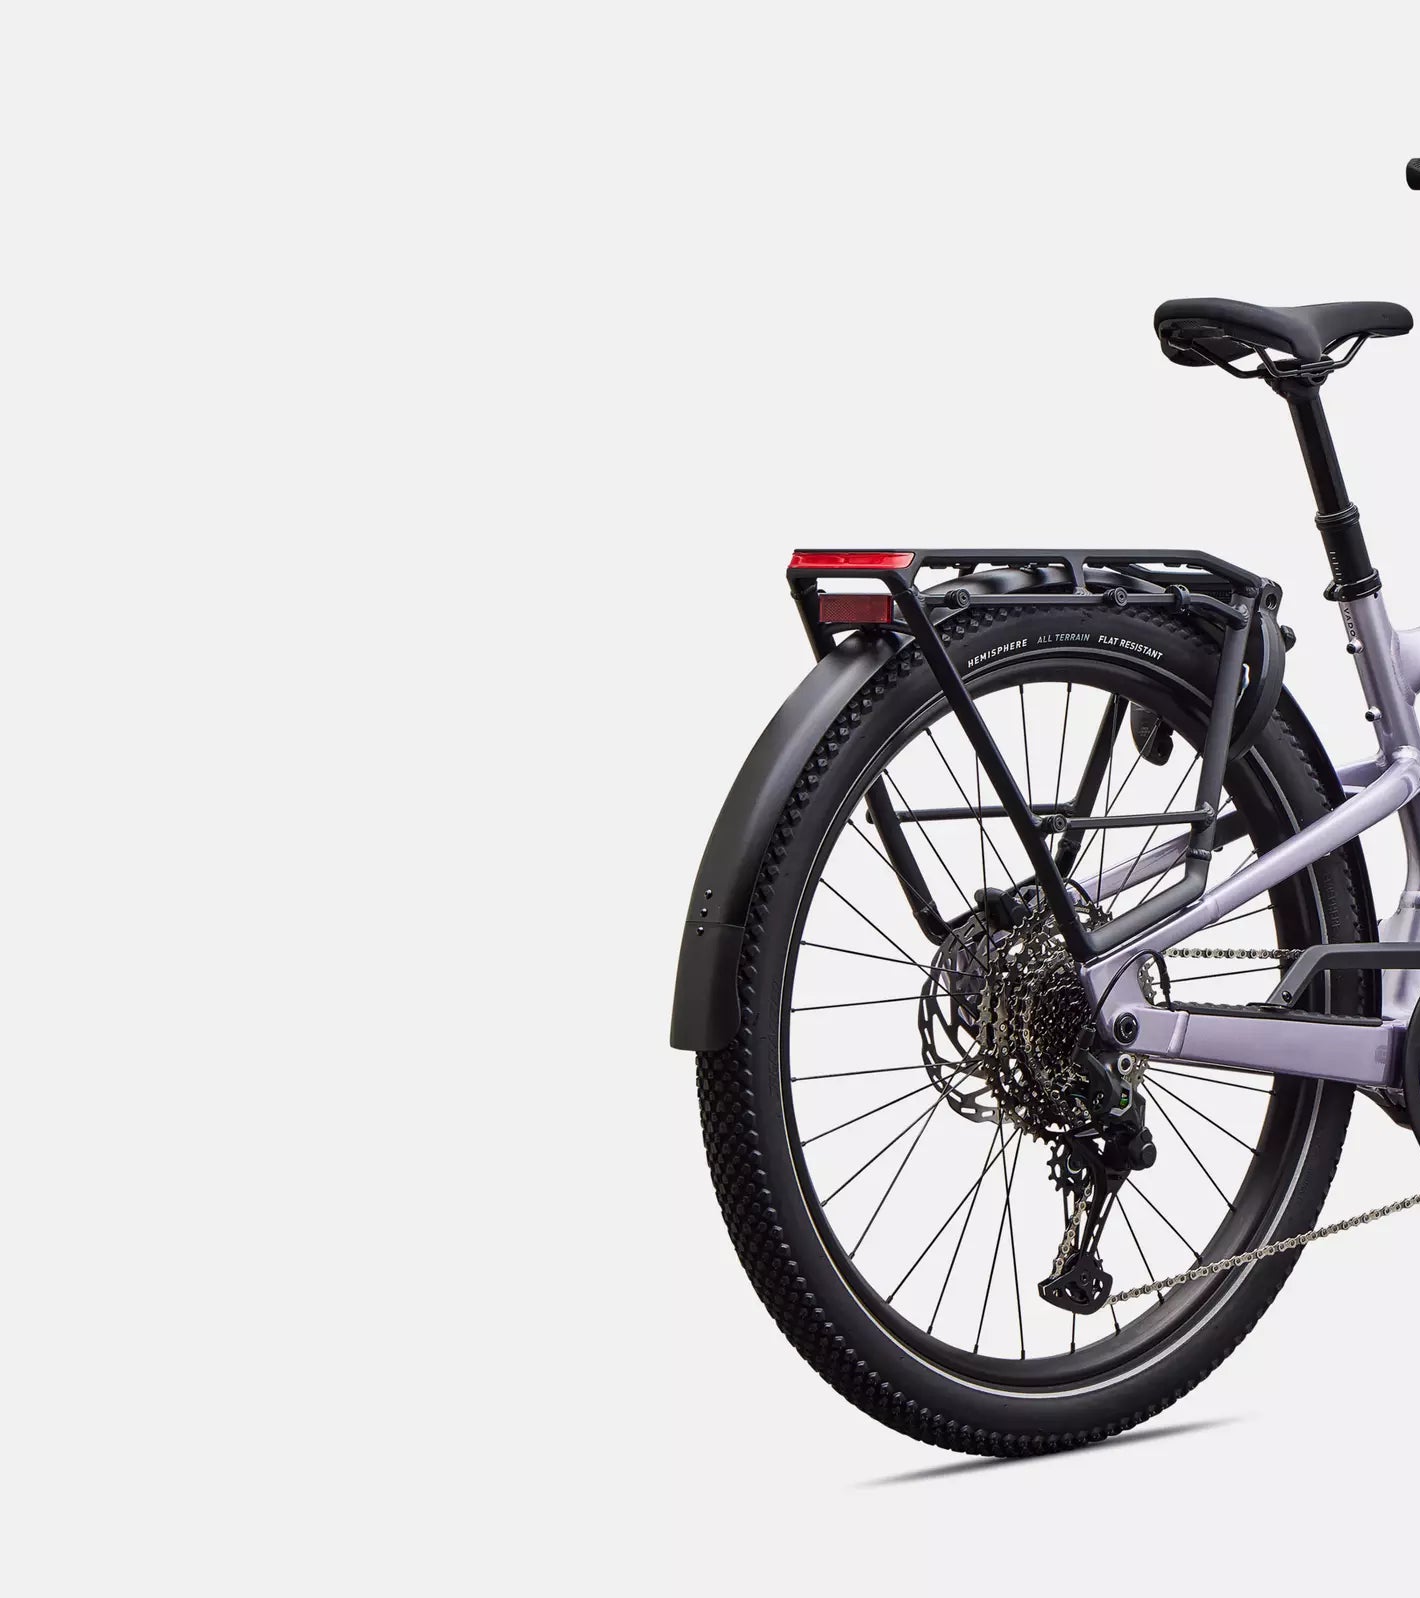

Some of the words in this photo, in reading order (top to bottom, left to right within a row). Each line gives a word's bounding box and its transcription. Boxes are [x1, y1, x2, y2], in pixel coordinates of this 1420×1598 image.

[1343, 607, 1356, 637] VADO
[967, 638, 1028, 668] HEMISPHERE
[1037, 634, 1053, 644] ALL
[1055, 633, 1091, 642] TERRAIN
[1098, 635, 1119, 646] FLAT
[1119, 639, 1164, 661] RESISTANT
